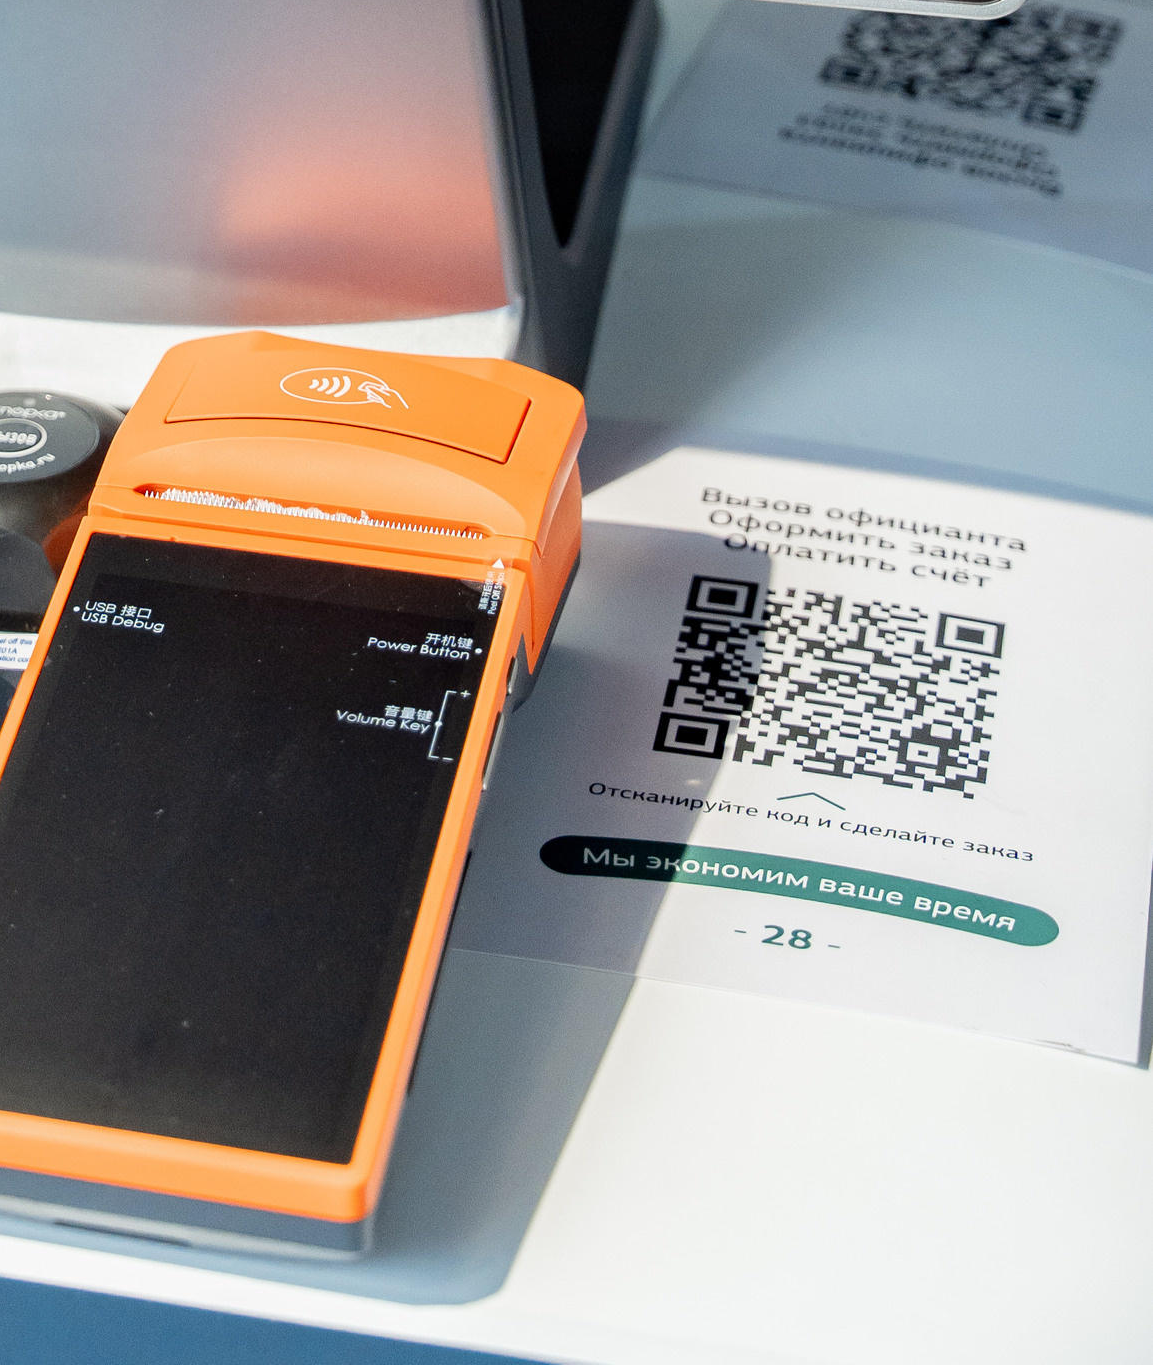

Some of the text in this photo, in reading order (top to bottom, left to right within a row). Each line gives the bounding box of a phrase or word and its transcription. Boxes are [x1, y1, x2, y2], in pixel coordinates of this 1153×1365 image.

[701, 487, 1027, 552] Вызов официанта
[709, 509, 1013, 571] Оформить заказ
[724, 533, 992, 588] Оплатить счёт
[85, 600, 152, 619] USB 接口
[487, 600, 498, 615] Peel
[81, 611, 165, 633] USB Debug
[367, 636, 470, 660] Power Button
[425, 632, 474, 650] 开机键
[336, 709, 431, 735] Volume Key
[384, 705, 434, 722] 音量键
[589, 782, 1034, 862] Отсканируйте код и сделайте заказ
[583, 847, 1016, 931] Мы экономим ваше время
[761, 924, 813, 950] 28
